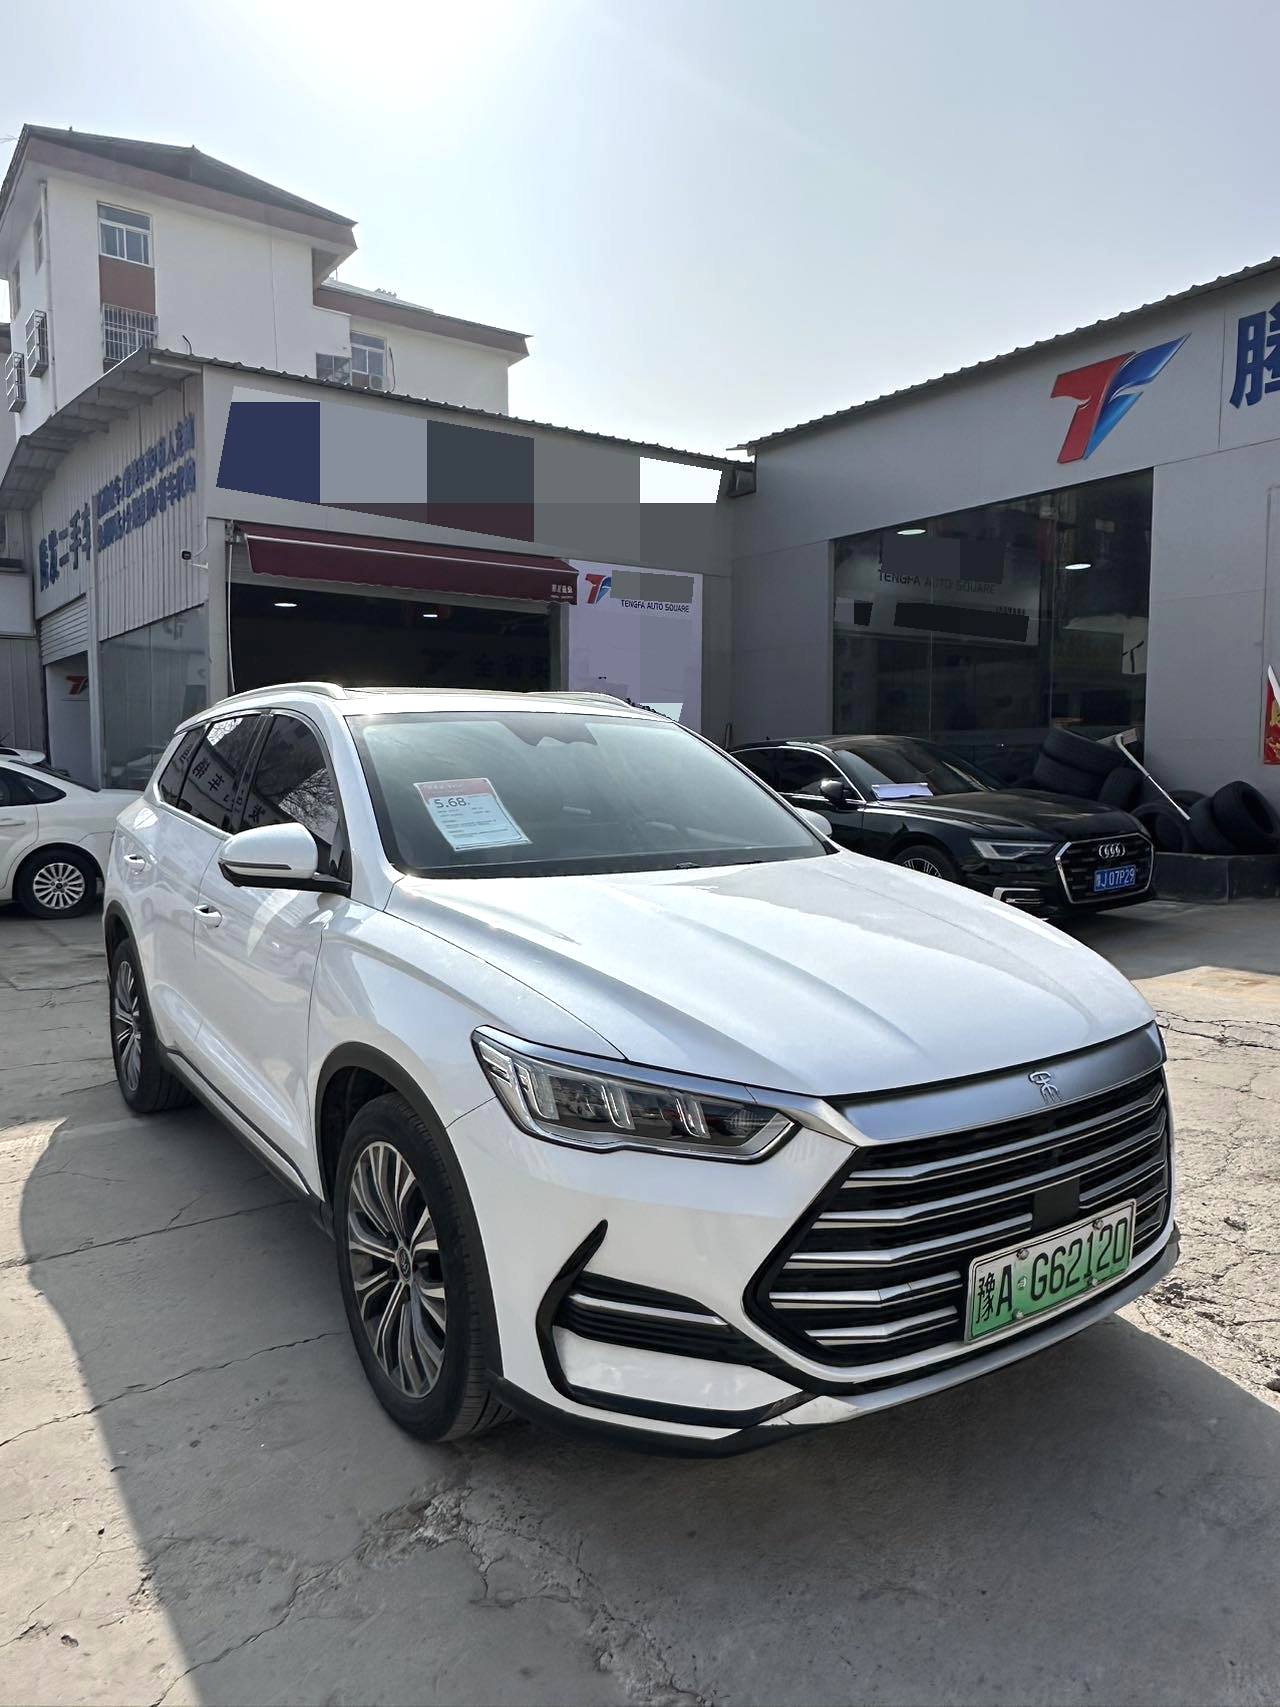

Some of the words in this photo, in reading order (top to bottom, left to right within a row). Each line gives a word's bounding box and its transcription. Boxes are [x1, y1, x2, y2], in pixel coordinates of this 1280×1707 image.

[621, 599, 646, 610] TENGFA
[647, 602, 664, 611] AUTO
[665, 603, 690, 613] SQUARE
